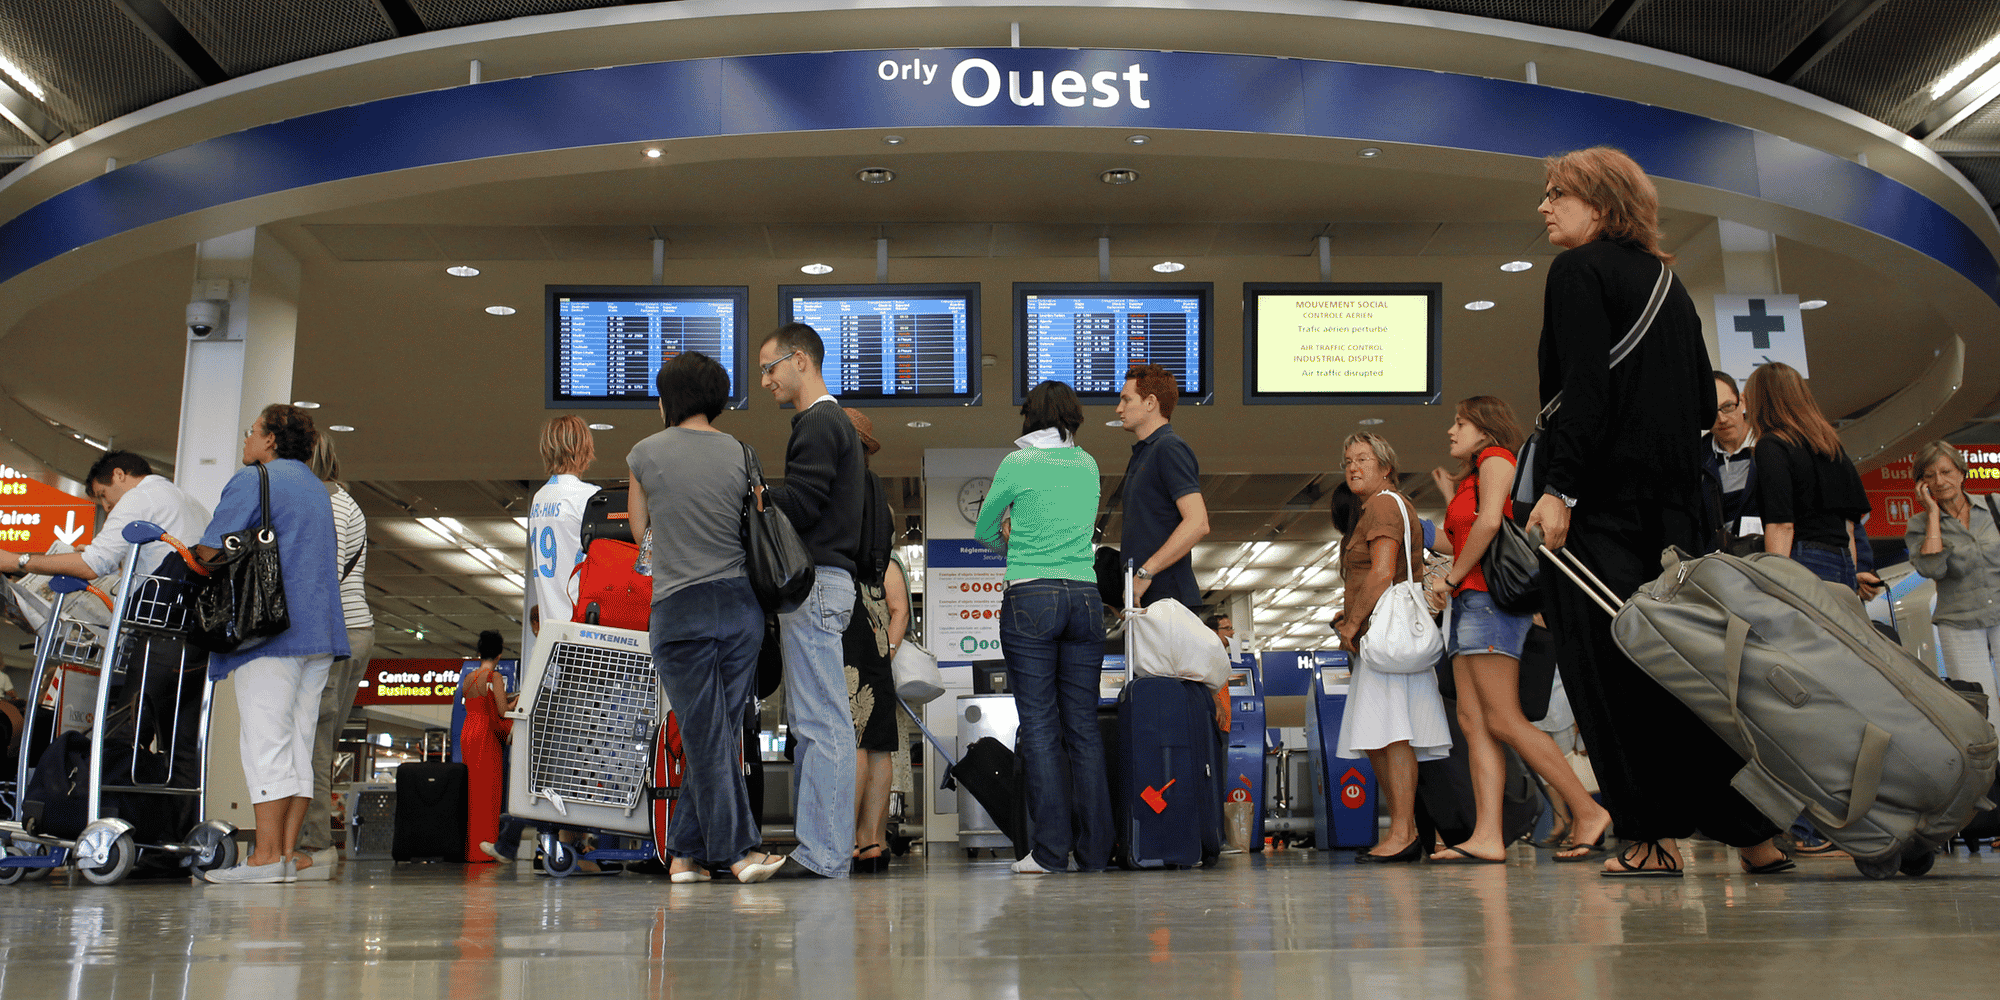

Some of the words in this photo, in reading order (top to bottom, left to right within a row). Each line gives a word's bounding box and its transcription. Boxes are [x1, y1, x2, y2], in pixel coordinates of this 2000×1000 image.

[878, 59, 938, 85] Orly
[951, 58, 1150, 108] Ouest
[1352, 325, 1388, 334] perturbé
[1344, 370, 1384, 378] disrupted
[1958, 449, 2000, 464] faire
[530, 526, 557, 578] 19
[579, 629, 639, 647] SKYKENNEL
[378, 671, 420, 683] Centre
[377, 684, 431, 696] Business
